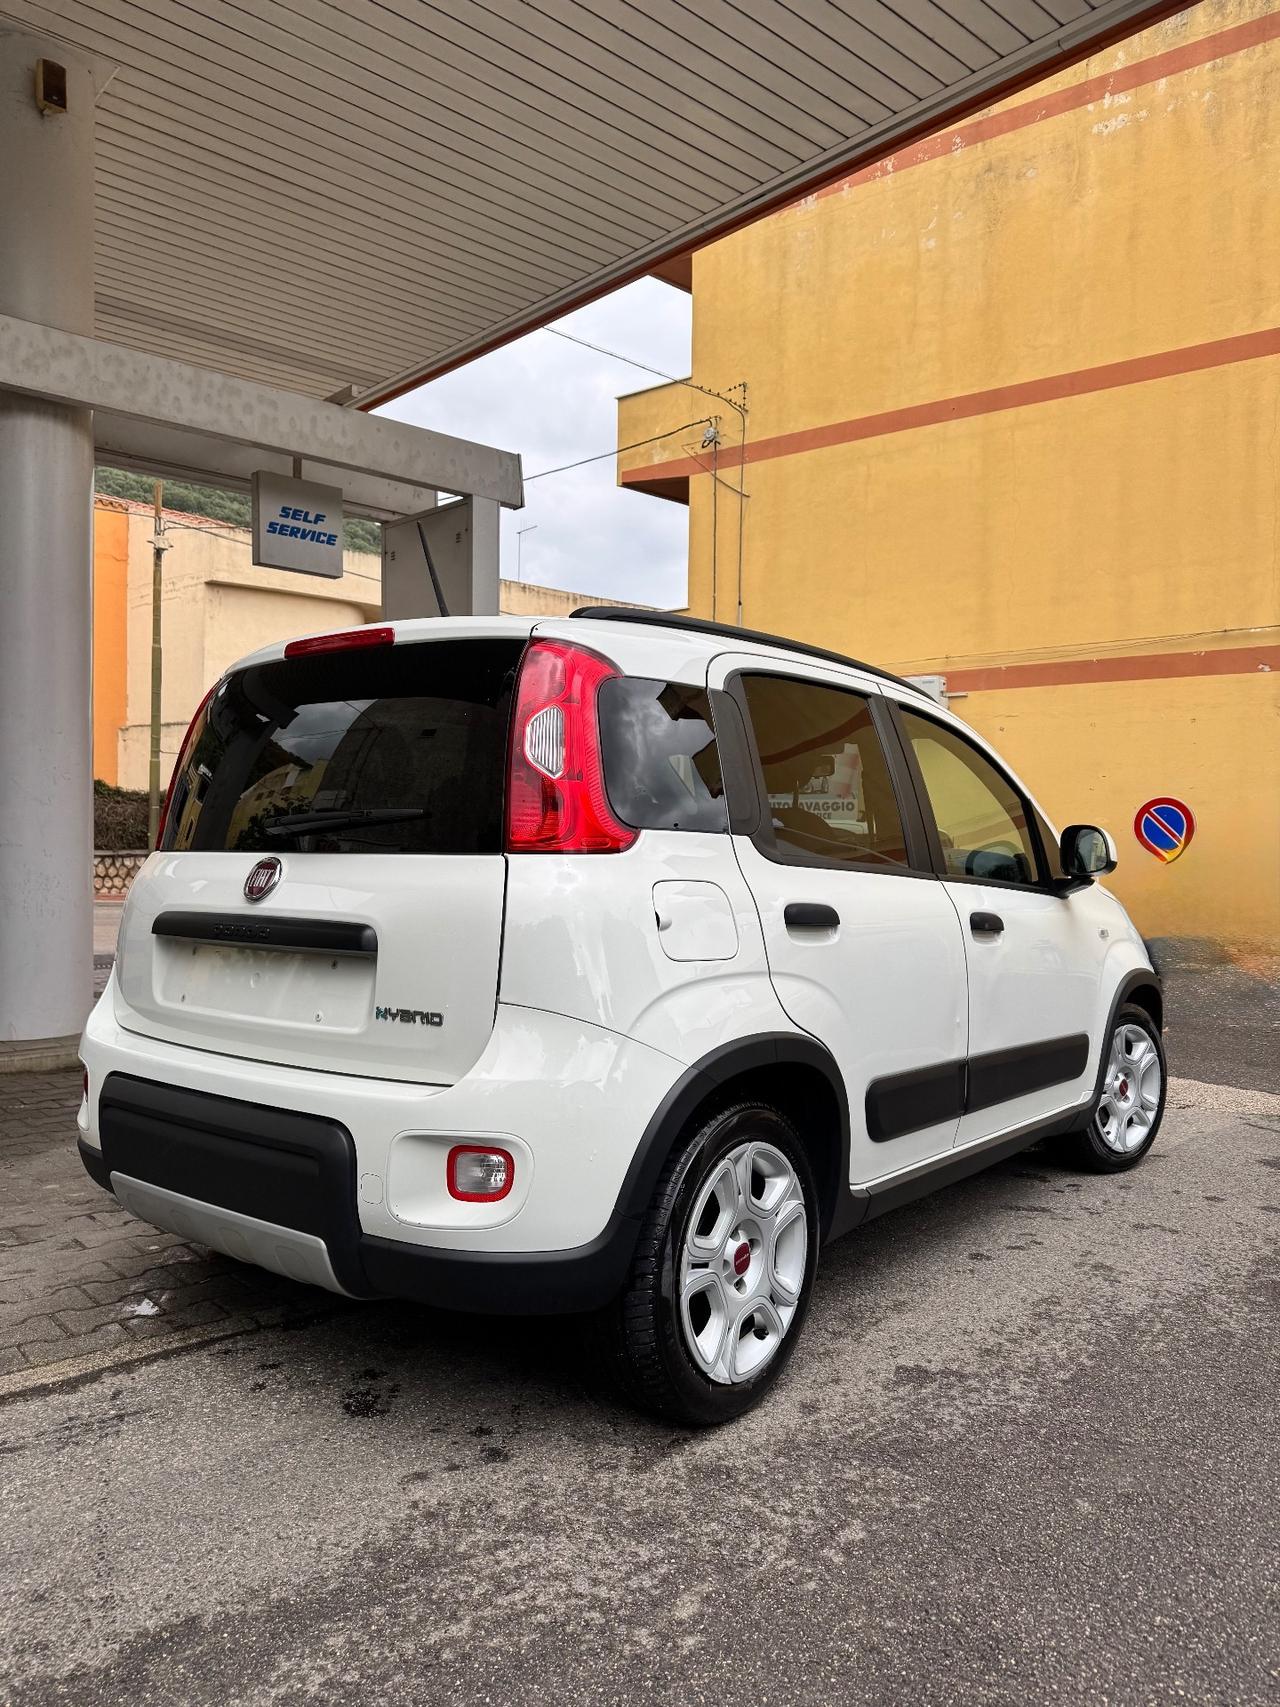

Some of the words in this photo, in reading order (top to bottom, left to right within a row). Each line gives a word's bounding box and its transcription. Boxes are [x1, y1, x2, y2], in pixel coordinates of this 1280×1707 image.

[279, 506, 326, 525] SELF
[266, 521, 338, 546] SERVICE
[249, 868, 276, 888] FIAT
